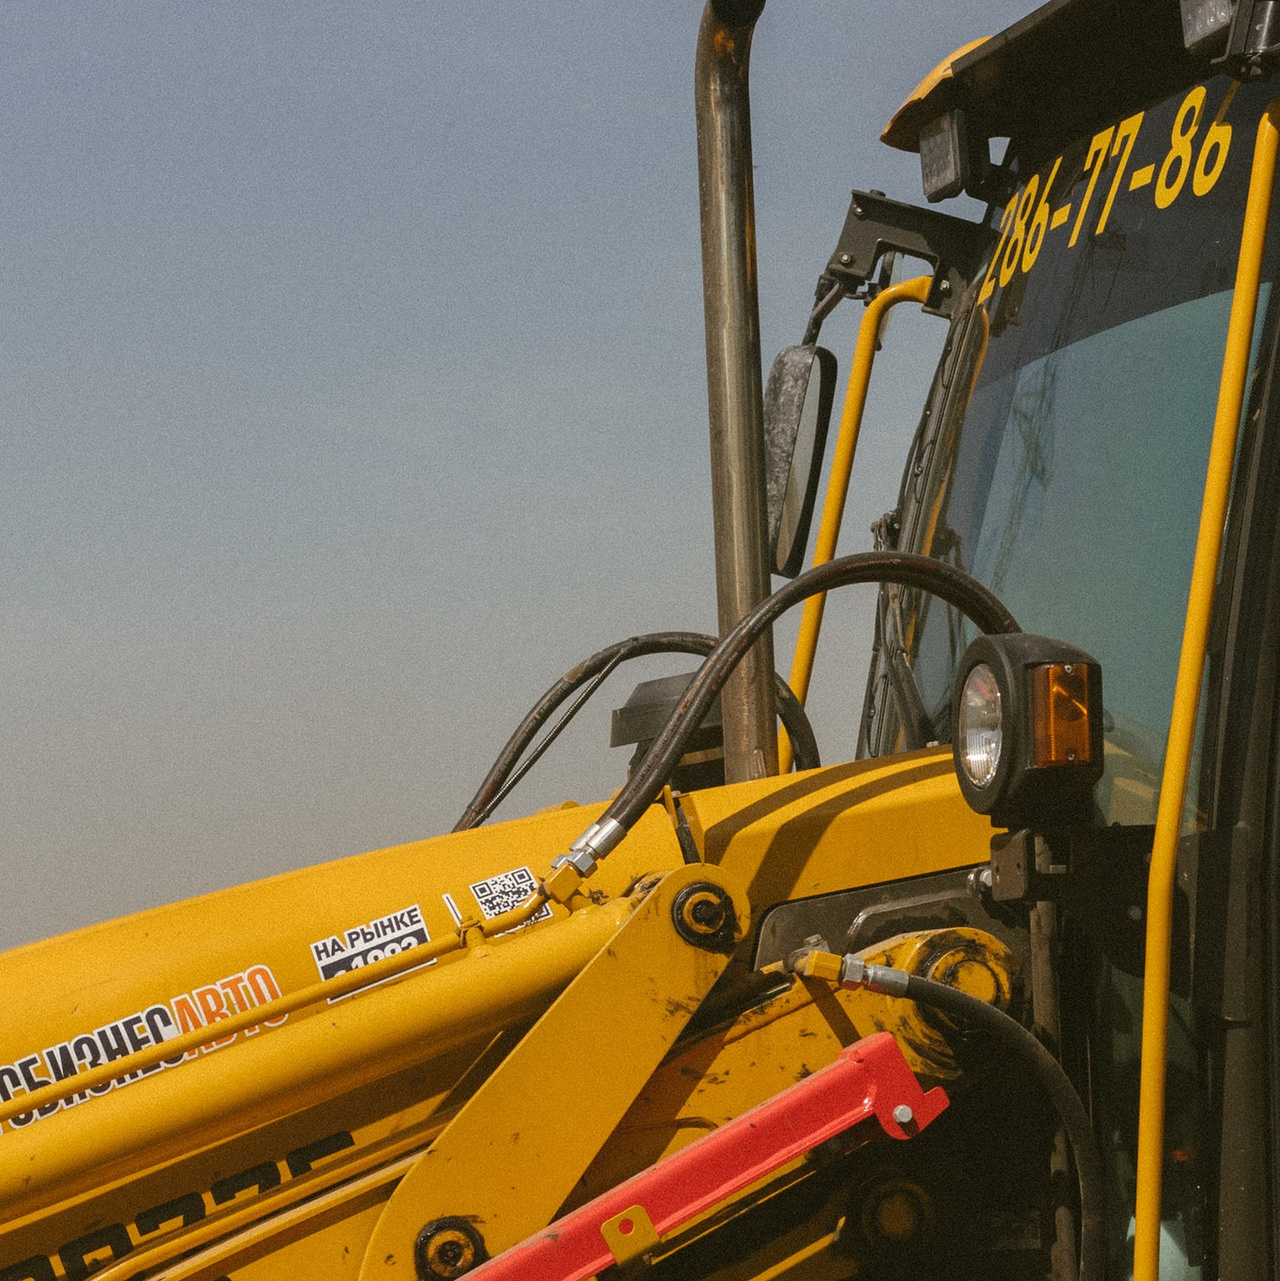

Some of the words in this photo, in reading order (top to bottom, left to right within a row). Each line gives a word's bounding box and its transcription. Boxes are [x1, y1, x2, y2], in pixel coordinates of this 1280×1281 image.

[976, 81, 1238, 306] 286-77-86
[314, 938, 345, 962] НА
[347, 907, 421, 949] РЫНКЕ
